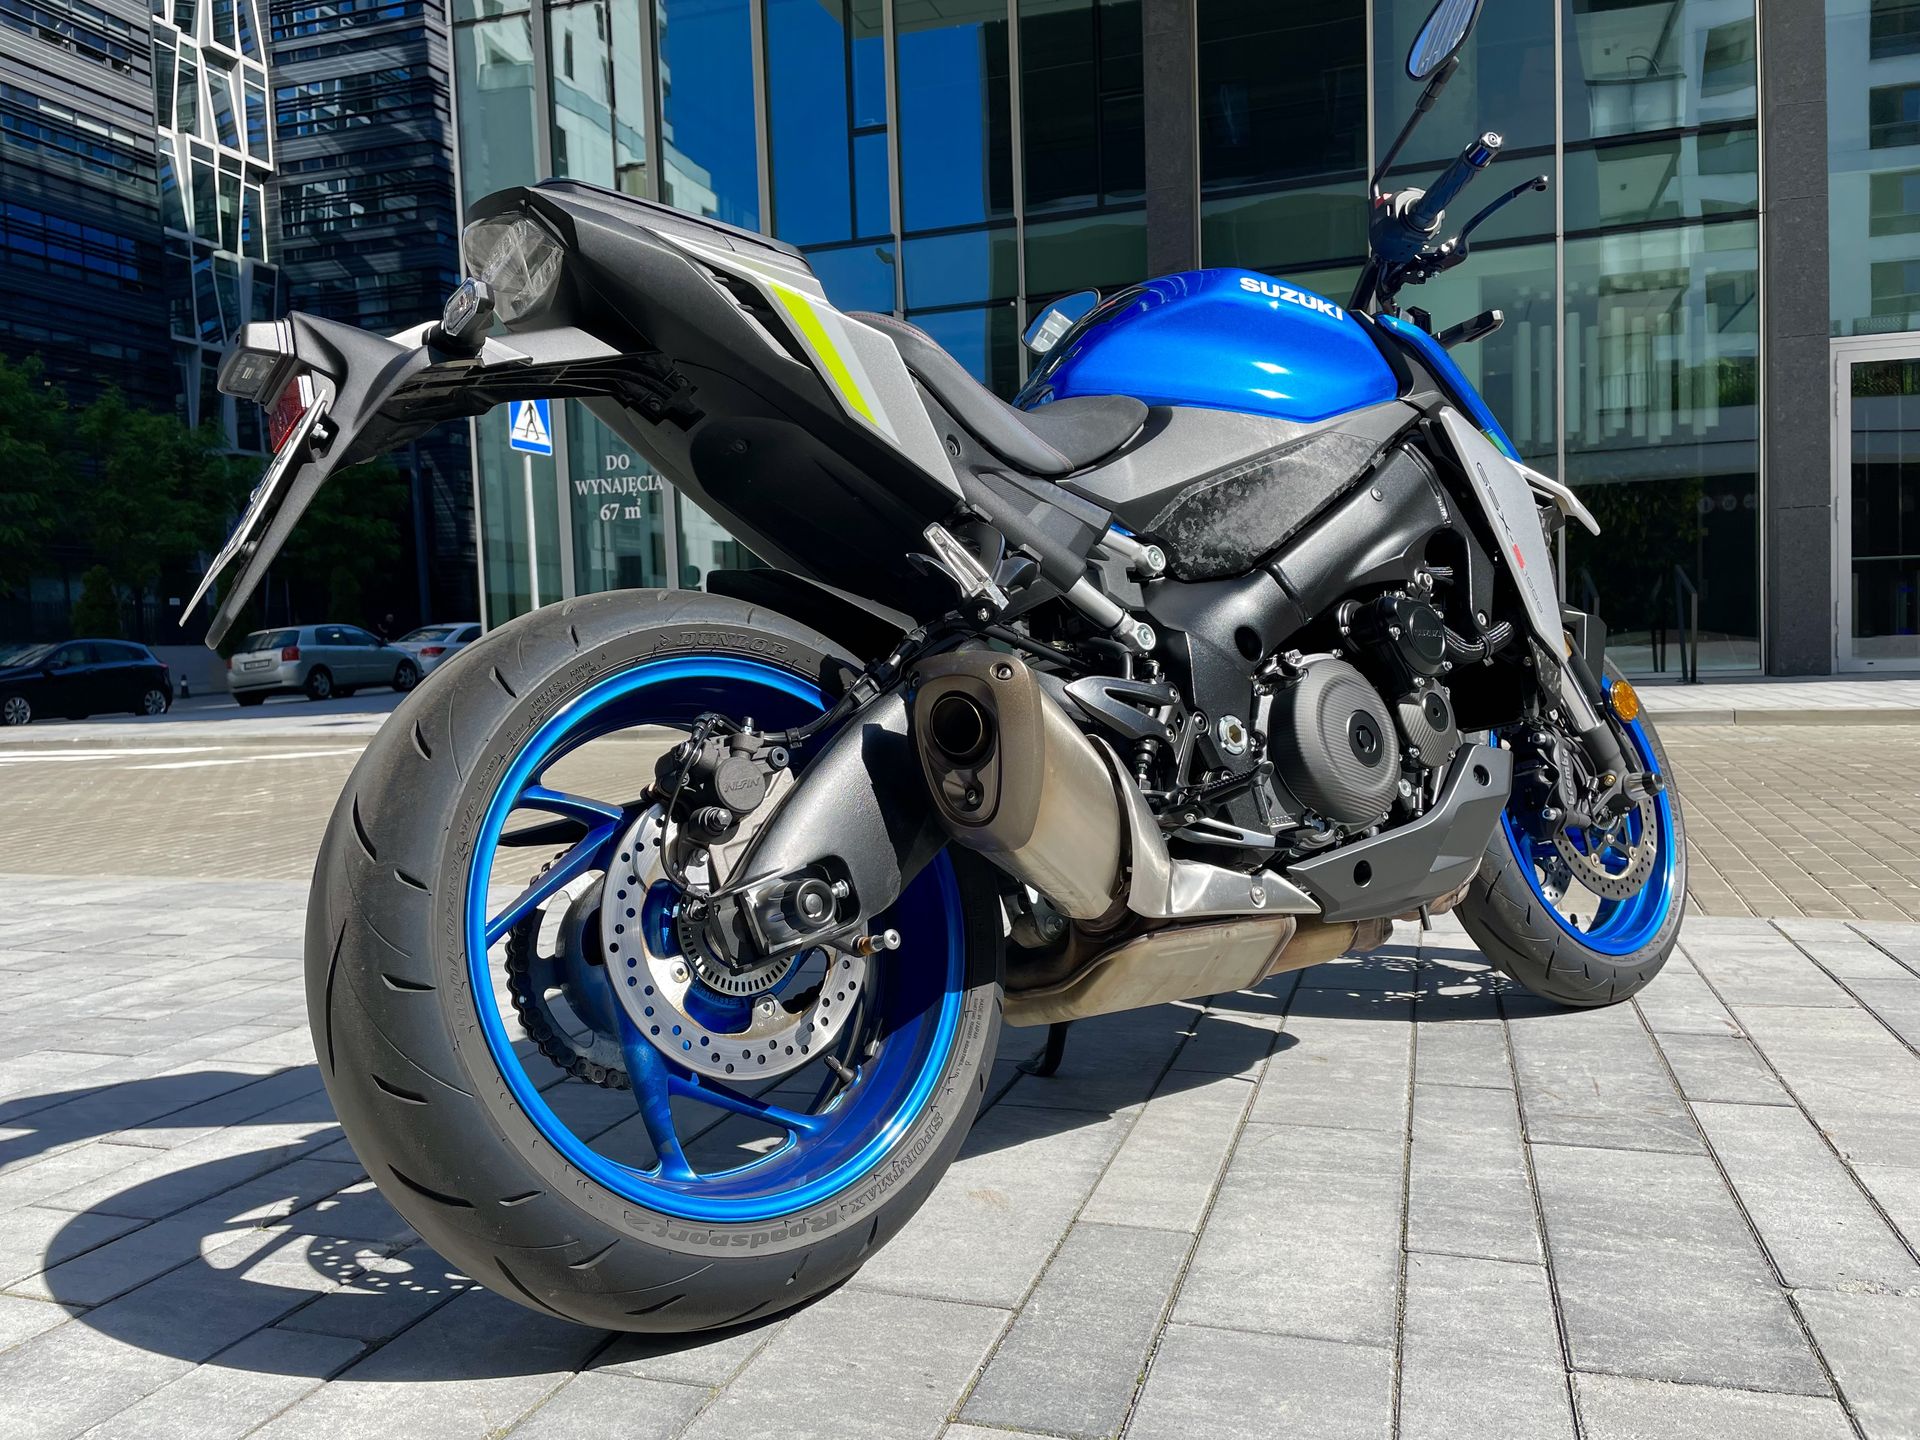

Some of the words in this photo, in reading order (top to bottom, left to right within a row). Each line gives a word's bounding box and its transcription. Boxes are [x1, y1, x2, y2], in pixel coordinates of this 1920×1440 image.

[1239, 277, 1344, 321] SUZUKI
[605, 453, 630, 471] DO
[574, 474, 664, 497] WYNAJĘCIA
[600, 503, 620, 521] 67
[676, 631, 788, 656] DUNLOP
[1562, 748, 1576, 806] brembo
[848, 1111, 944, 1214] SPORTMAX
[651, 1208, 838, 1249] Roadsport
